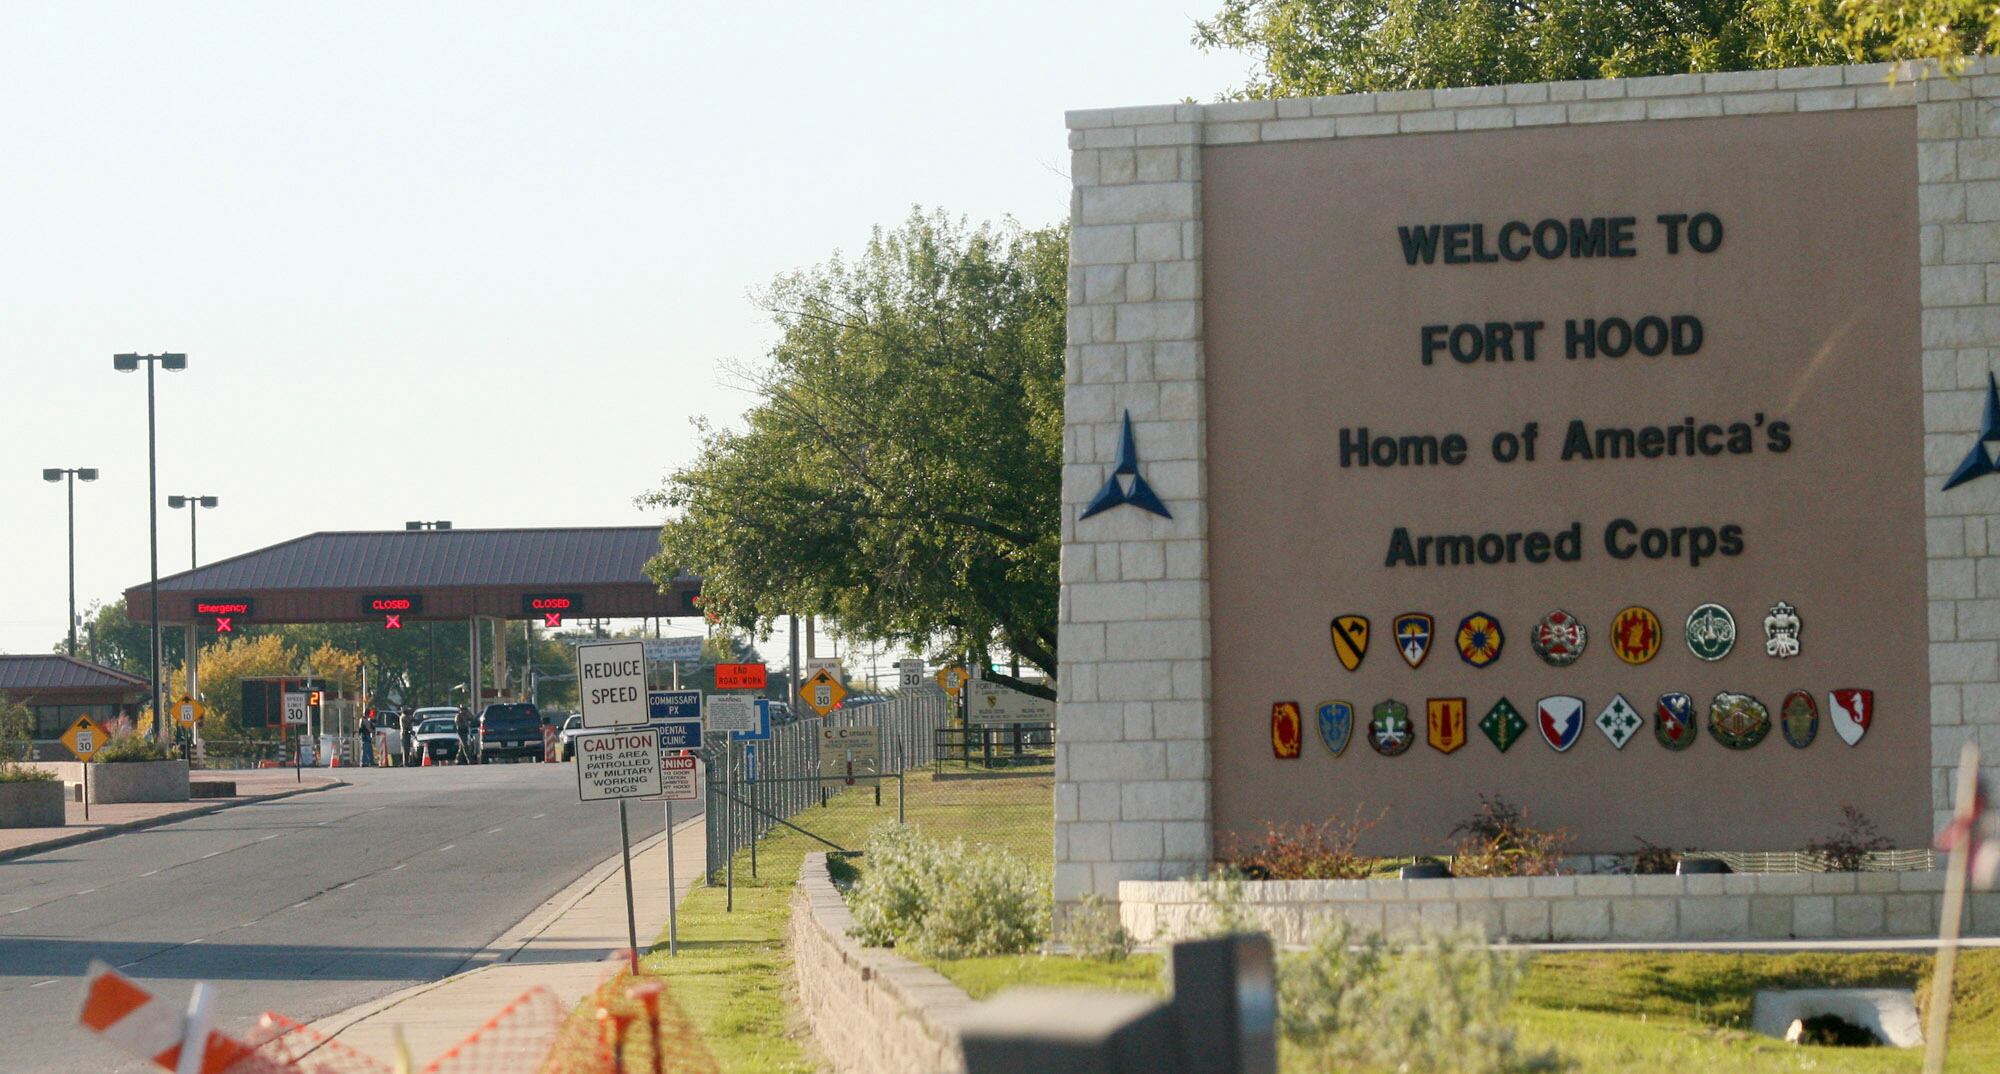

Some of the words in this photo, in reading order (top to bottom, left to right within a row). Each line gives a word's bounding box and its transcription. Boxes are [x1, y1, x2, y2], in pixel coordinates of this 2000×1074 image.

[1398, 216, 1637, 266] WELCOME
[1656, 212, 1723, 254] TO
[1421, 320, 1545, 366] FORT
[1565, 315, 1704, 360] HOOD
[1339, 427, 1468, 467] Home
[1491, 421, 1538, 462] of
[1561, 412, 1792, 460] America's
[1384, 522, 1582, 567] Armored
[1604, 518, 1744, 567] Corps
[198, 603, 248, 614] Emergency
[372, 599, 410, 609] CLOSED
[532, 599, 570, 608] CLOSED
[584, 660, 641, 679] REDUCE
[733, 666, 747, 675] END
[719, 677, 738, 685] ROAD
[742, 676, 762, 684] WORK
[903, 673, 920, 685] 30
[591, 686, 638, 704] SPEED
[649, 695, 698, 706] COMMISSARY
[816, 696, 830, 705] 30
[287, 708, 303, 720] 30
[669, 706, 679, 714] PX
[660, 725, 687, 735] DENTAL
[583, 735, 652, 752] CAUTION
[662, 736, 686, 745] CLINIC
[79, 742, 92, 751] 30
[588, 752, 613, 761] THIS
[618, 750, 649, 758] AREA
[587, 758, 651, 770] PATROLLED
[661, 758, 693, 769] RNING
[584, 771, 599, 779] BY
[604, 766, 653, 777] MILITARY
[593, 775, 648, 786] WORKING
[604, 785, 638, 794] DOGS
